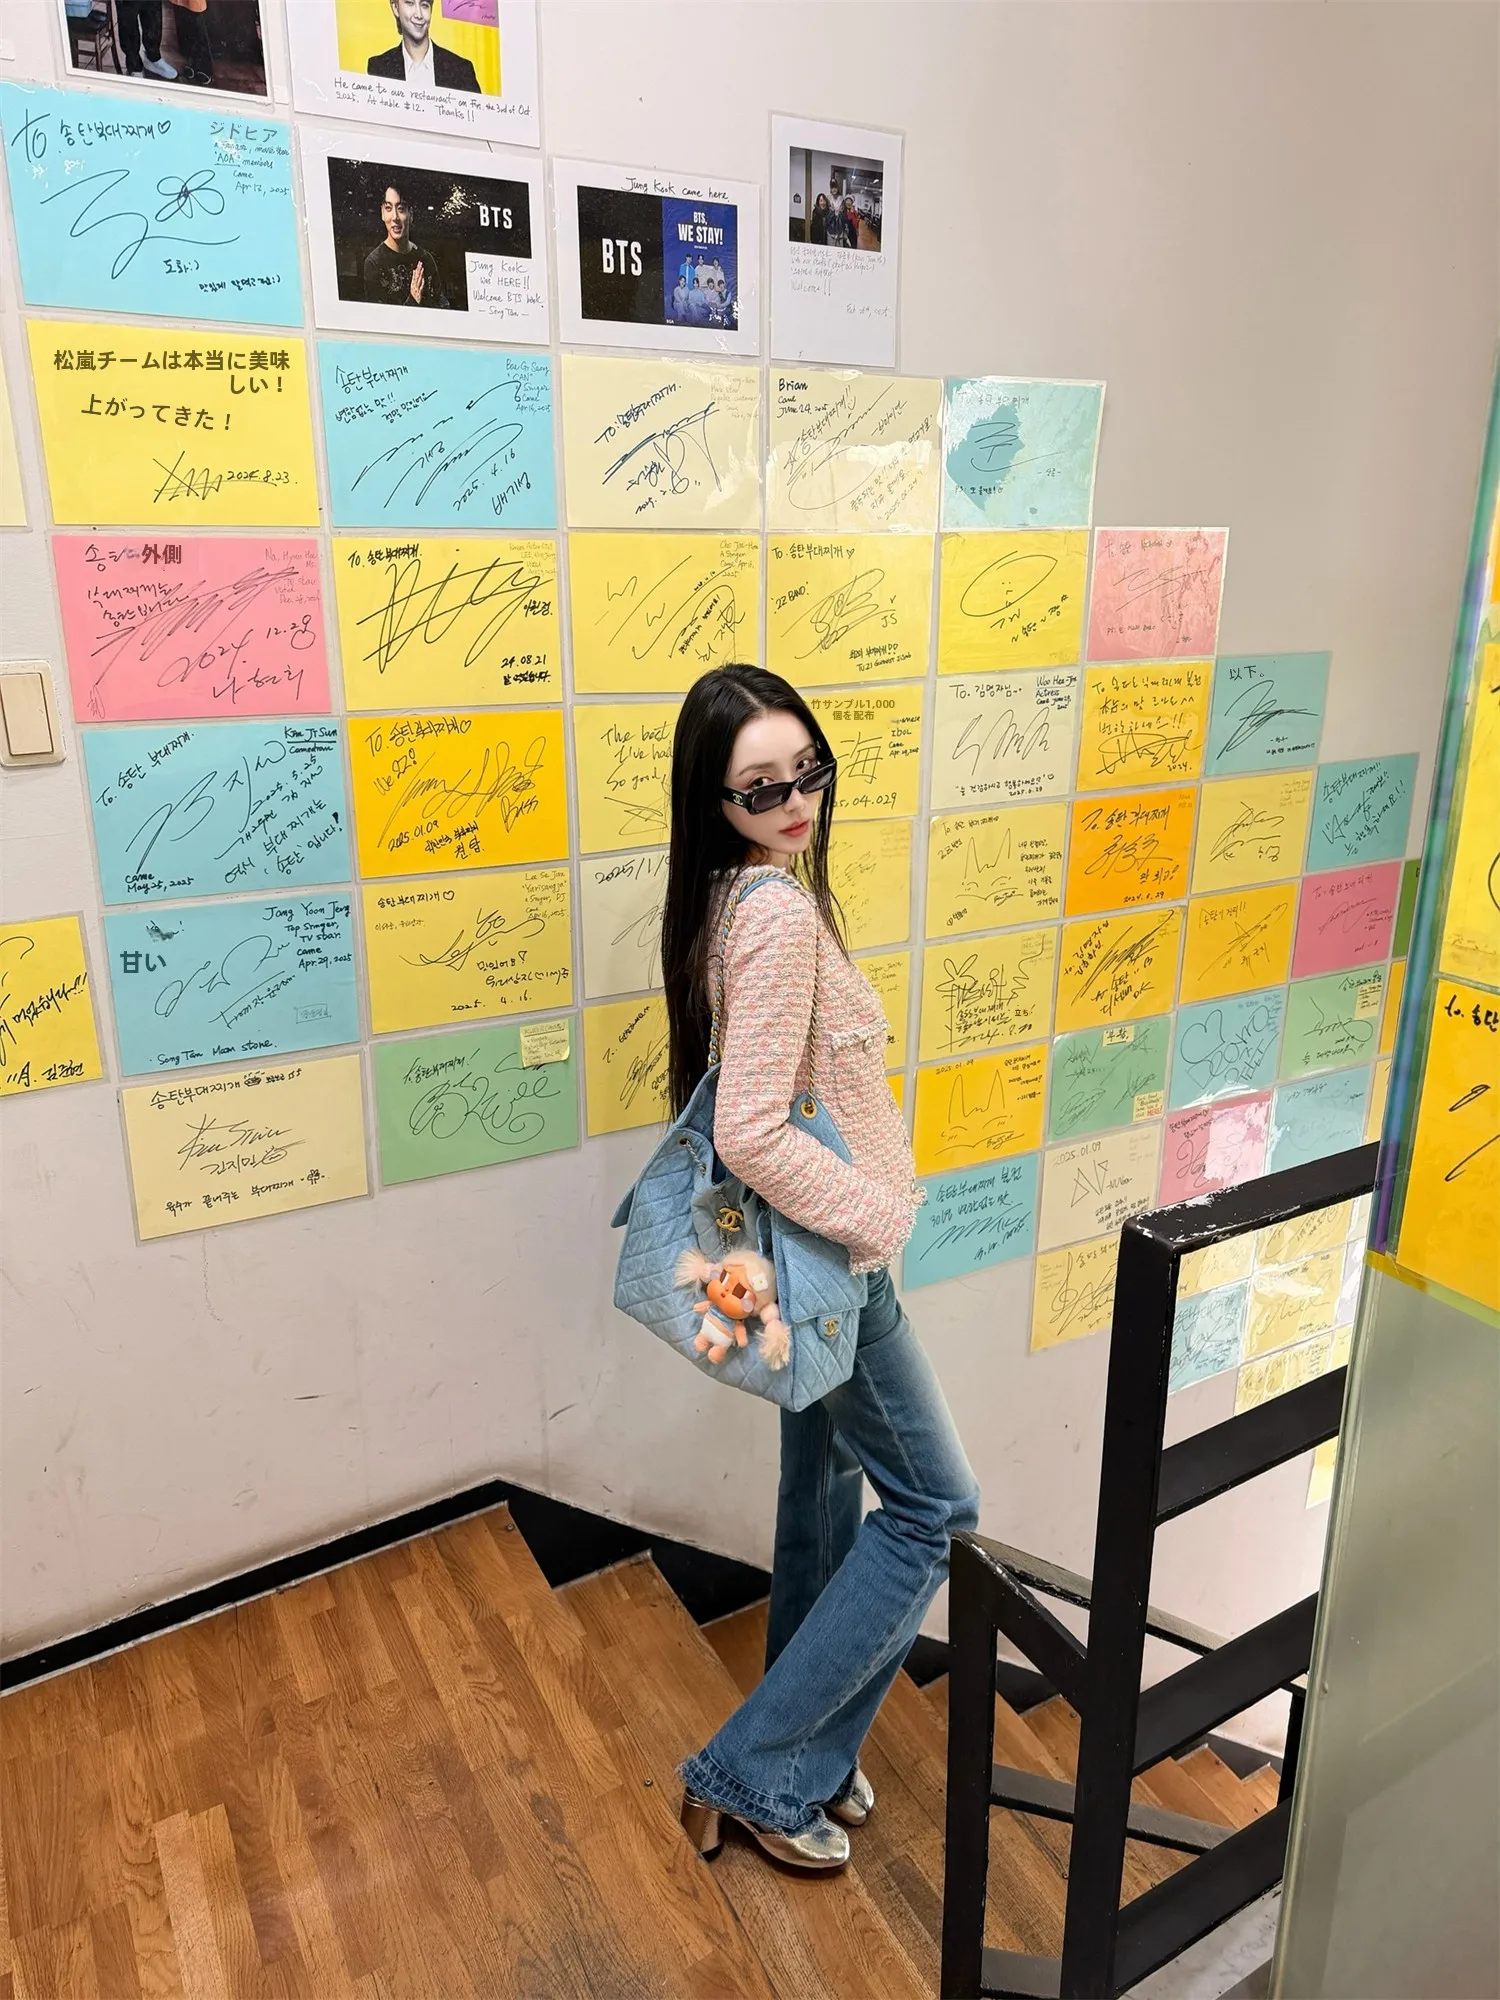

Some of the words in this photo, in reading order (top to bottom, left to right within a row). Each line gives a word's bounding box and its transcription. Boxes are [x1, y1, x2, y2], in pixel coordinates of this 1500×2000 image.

[334, 78, 348, 88] He
[352, 83, 372, 91] came
[376, 83, 387, 93] to
[391, 89, 405, 97] our
[410, 90, 456, 104] restaurant
[380, 98, 400, 109] table
[210, 121, 277, 143] ジドヒア
[621, 177, 648, 192] Jung
[654, 179, 675, 194] Kook
[682, 188, 703, 198] came
[480, 206, 512, 229] BTS
[693, 212, 707, 225] BTS,
[678, 224, 694, 241] WE
[696, 225, 723, 245] STAY!
[602, 238, 643, 276] BTS
[468, 261, 494, 277] Jung
[501, 260, 528, 273] Kook
[54, 350, 290, 371] 松嵐チームは本当に美味
[230, 375, 283, 395] しい！
[336, 365, 409, 394] 송탄부대찌개
[778, 378, 808, 392] Brian
[81, 393, 231, 431] 上がってきた！
[142, 544, 182, 565] 外側
[949, 684, 970, 699] To.
[833, 711, 874, 720] 個を配布
[319, 727, 338, 737] Sun
[601, 724, 634, 746] The
[642, 721, 671, 742] best
[118, 764, 147, 789] 송탄
[169, 877, 195, 887] 2025
[263, 906, 294, 922] Jang
[301, 902, 325, 916] Yoon
[120, 950, 167, 974] 甘い
[297, 948, 322, 956] came
[334, 953, 352, 962] 2025
[157, 1054, 180, 1065] Song
[181, 1050, 203, 1060] Tan
[150, 1081, 240, 1110] 송탄부대찌개
[165, 1200, 193, 1217] 육수가
[202, 1191, 240, 1209] 끝내주는
[251, 1180, 294, 1197] 부대찌개
